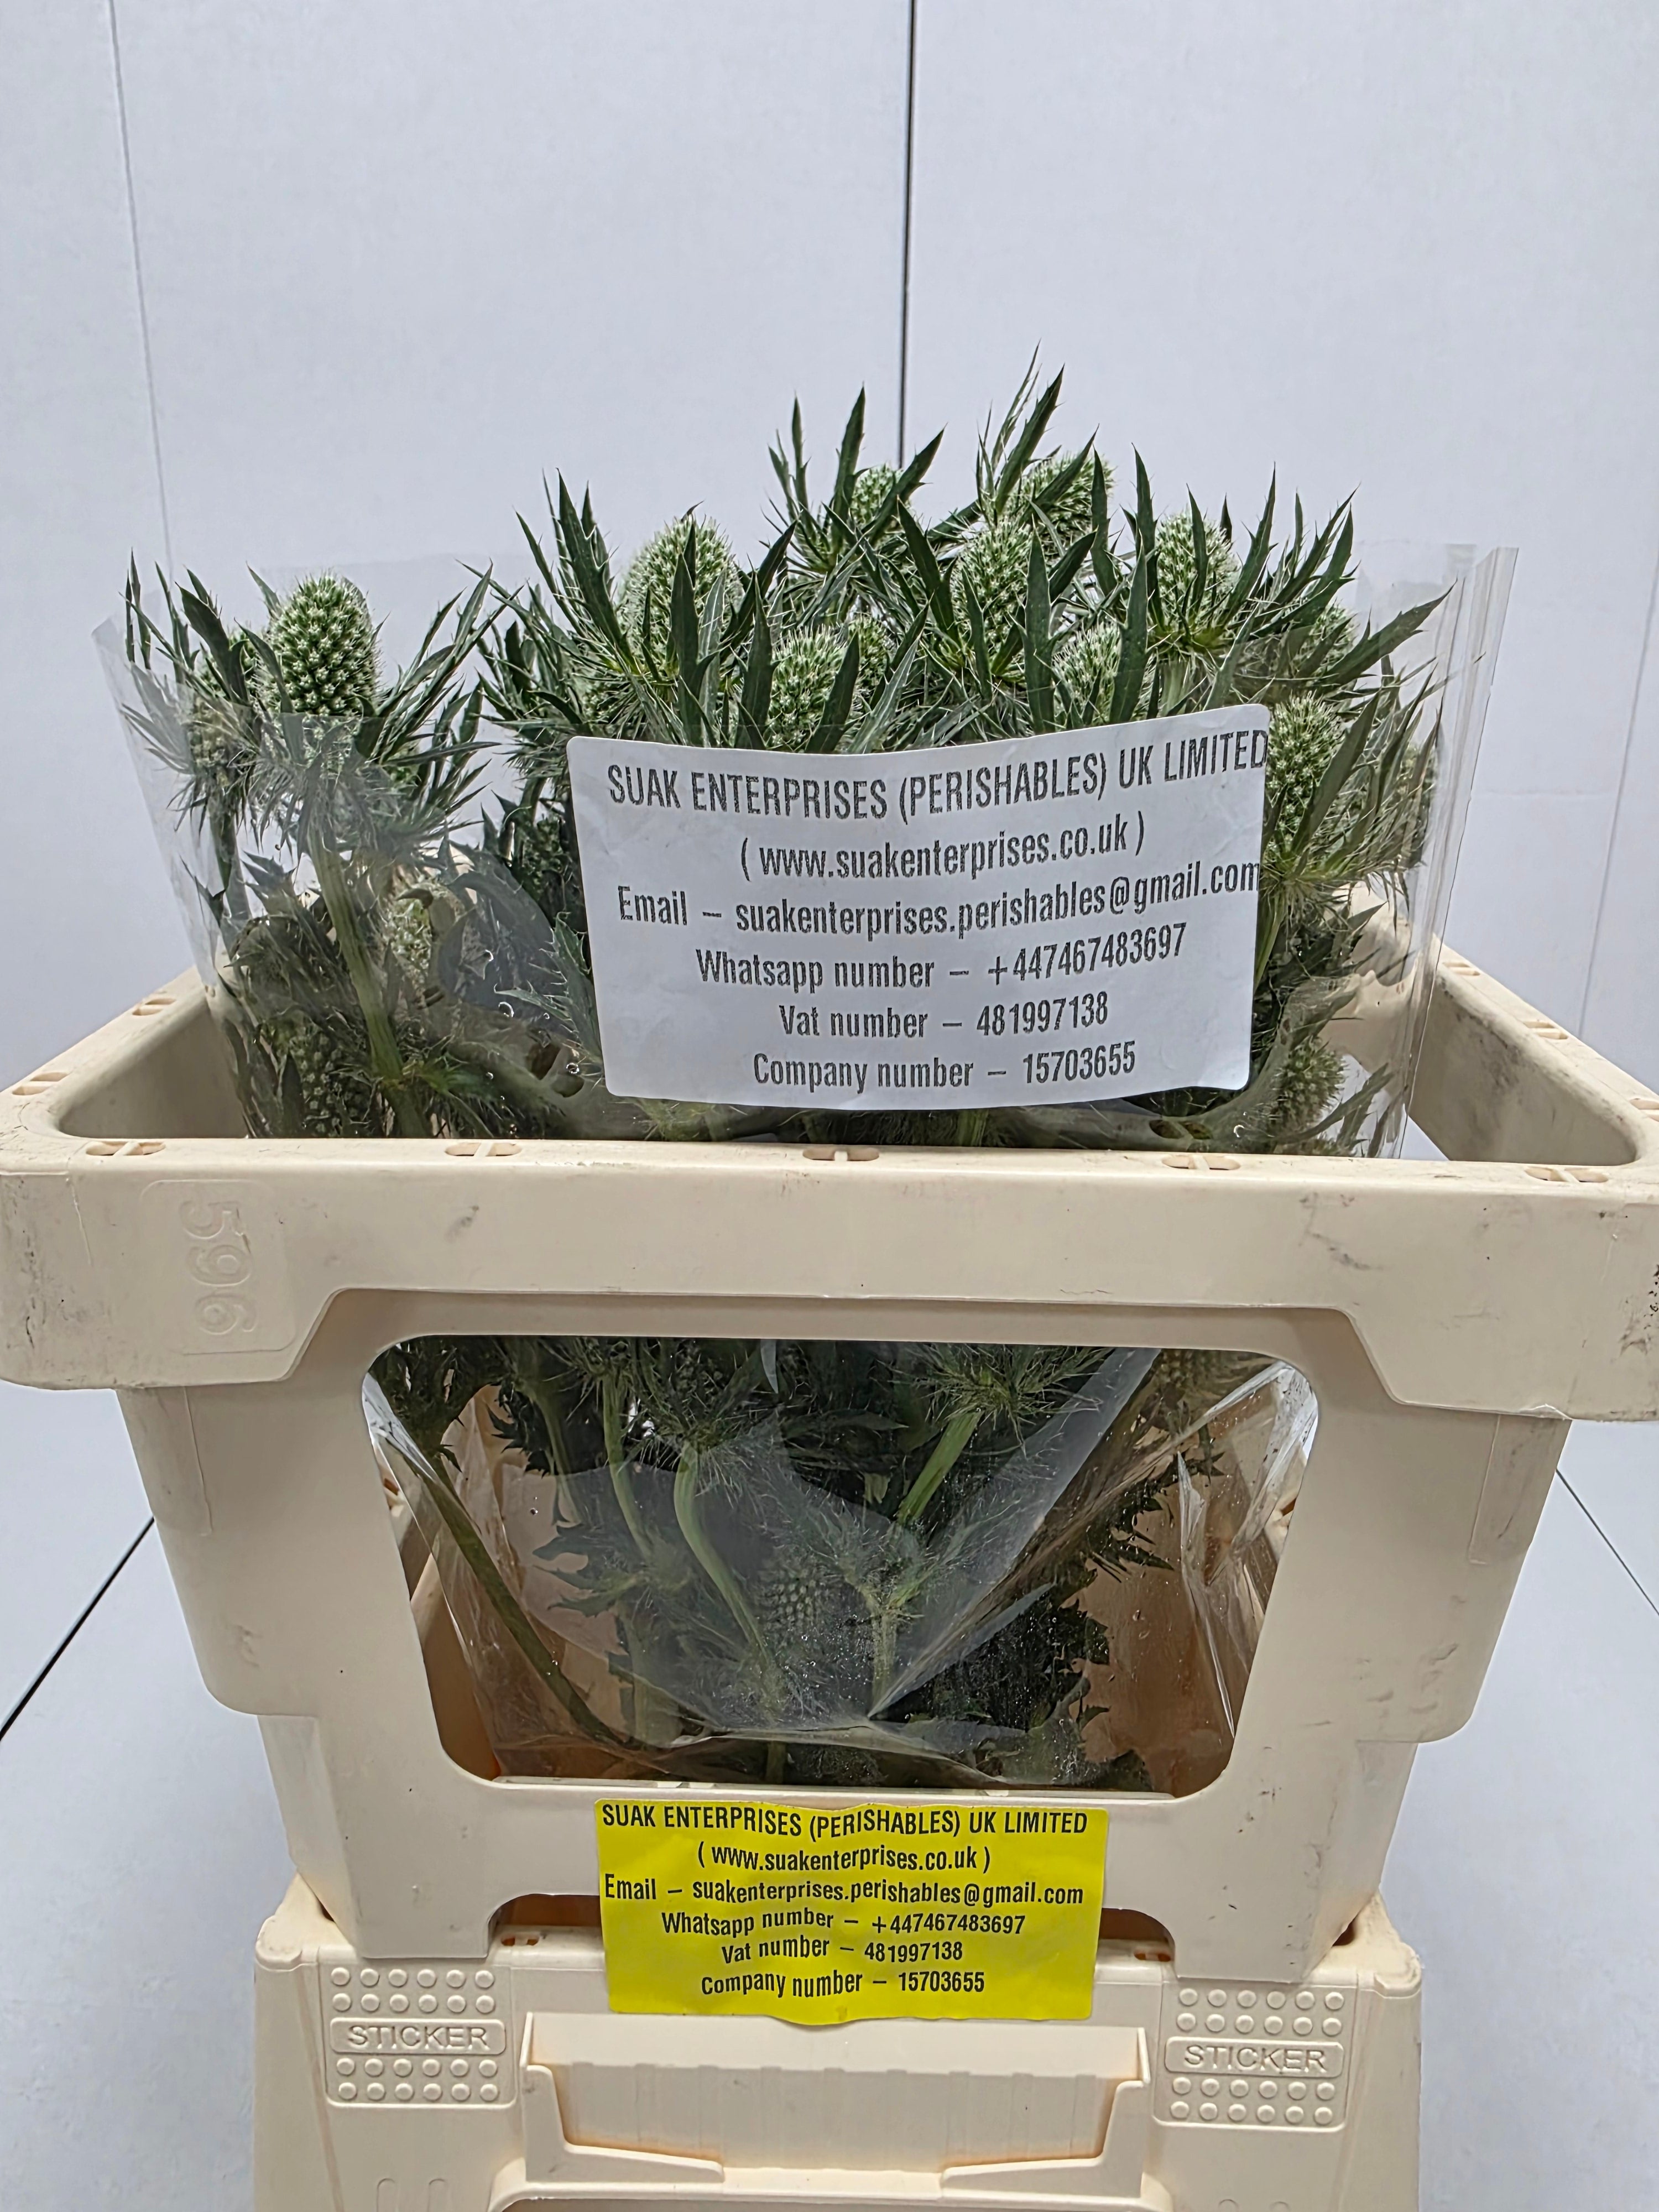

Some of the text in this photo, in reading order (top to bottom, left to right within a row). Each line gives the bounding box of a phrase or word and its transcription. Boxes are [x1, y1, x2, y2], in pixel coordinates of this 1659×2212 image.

[608, 730, 1267, 825] SUAK ENTERPRISES (PERISHABLES) UK LIMITED
[741, 811, 1144, 881] ( www.suakenterprises.co.uk )
[618, 886, 687, 925] Email
[736, 861, 1259, 941] suakenterprises.perishables@gmail.com
[696, 949, 822, 994] Whatsapp
[835, 956, 934, 988] number
[988, 922, 1187, 985] +447467483697
[779, 1005, 820, 1036] Vat
[831, 1008, 927, 1038] number
[977, 992, 1107, 1036] 481997138
[754, 1053, 867, 1094] Company
[878, 1057, 973, 1087] number
[1023, 1041, 1135, 1083] 15703655
[180, 1201, 257, 1335] 596
[603, 1804, 1087, 1842] SUAK ENTERPRISES (PERISHABLES) UK LIMITED
[698, 1841, 990, 1874] ( www.suakenterprises.co.uk )
[606, 1874, 656, 1900] Email
[693, 1879, 1083, 1907] suakenterprises.perishables@gmail.com
[662, 1912, 754, 1938] Whatsapp
[763, 1907, 833, 1928] number
[872, 1913, 1025, 1934] +447467483697
[722, 1943, 751, 1964] Vat
[759, 1935, 830, 1958] number
[865, 1942, 962, 1963] 481997138
[702, 1974, 785, 1997] Company
[793, 1970, 862, 1997] number
[899, 1971, 984, 1992] 15703655
[348, 2025, 491, 2050] STICKER
[1185, 2044, 1327, 2072] STICKER
